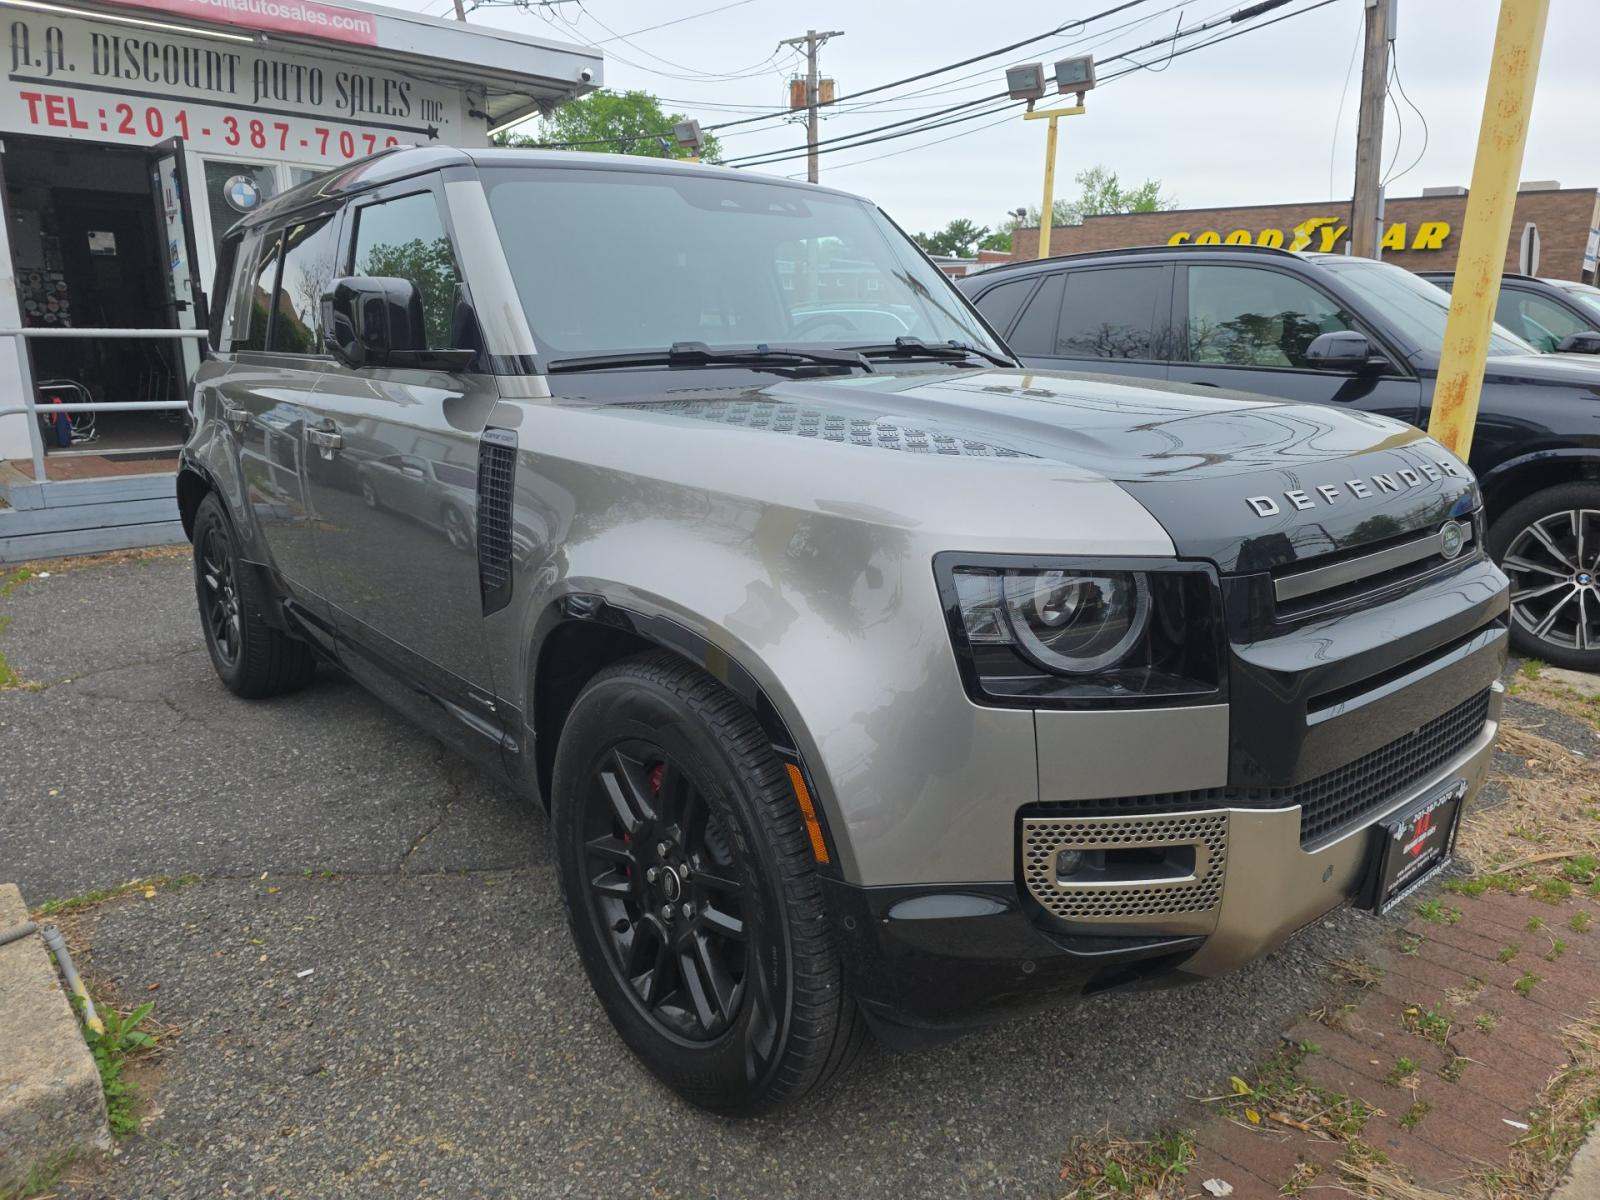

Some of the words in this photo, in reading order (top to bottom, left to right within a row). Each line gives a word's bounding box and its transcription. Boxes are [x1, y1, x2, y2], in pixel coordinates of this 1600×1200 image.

[9, 21, 75, 77] A.A.
[90, 31, 240, 94] DISCOUNT
[252, 58, 323, 105] AUTO
[335, 71, 411, 117] SALES
[1167, 221, 1450, 253] GOODYAR
[1245, 459, 1458, 518] DEFENDER
